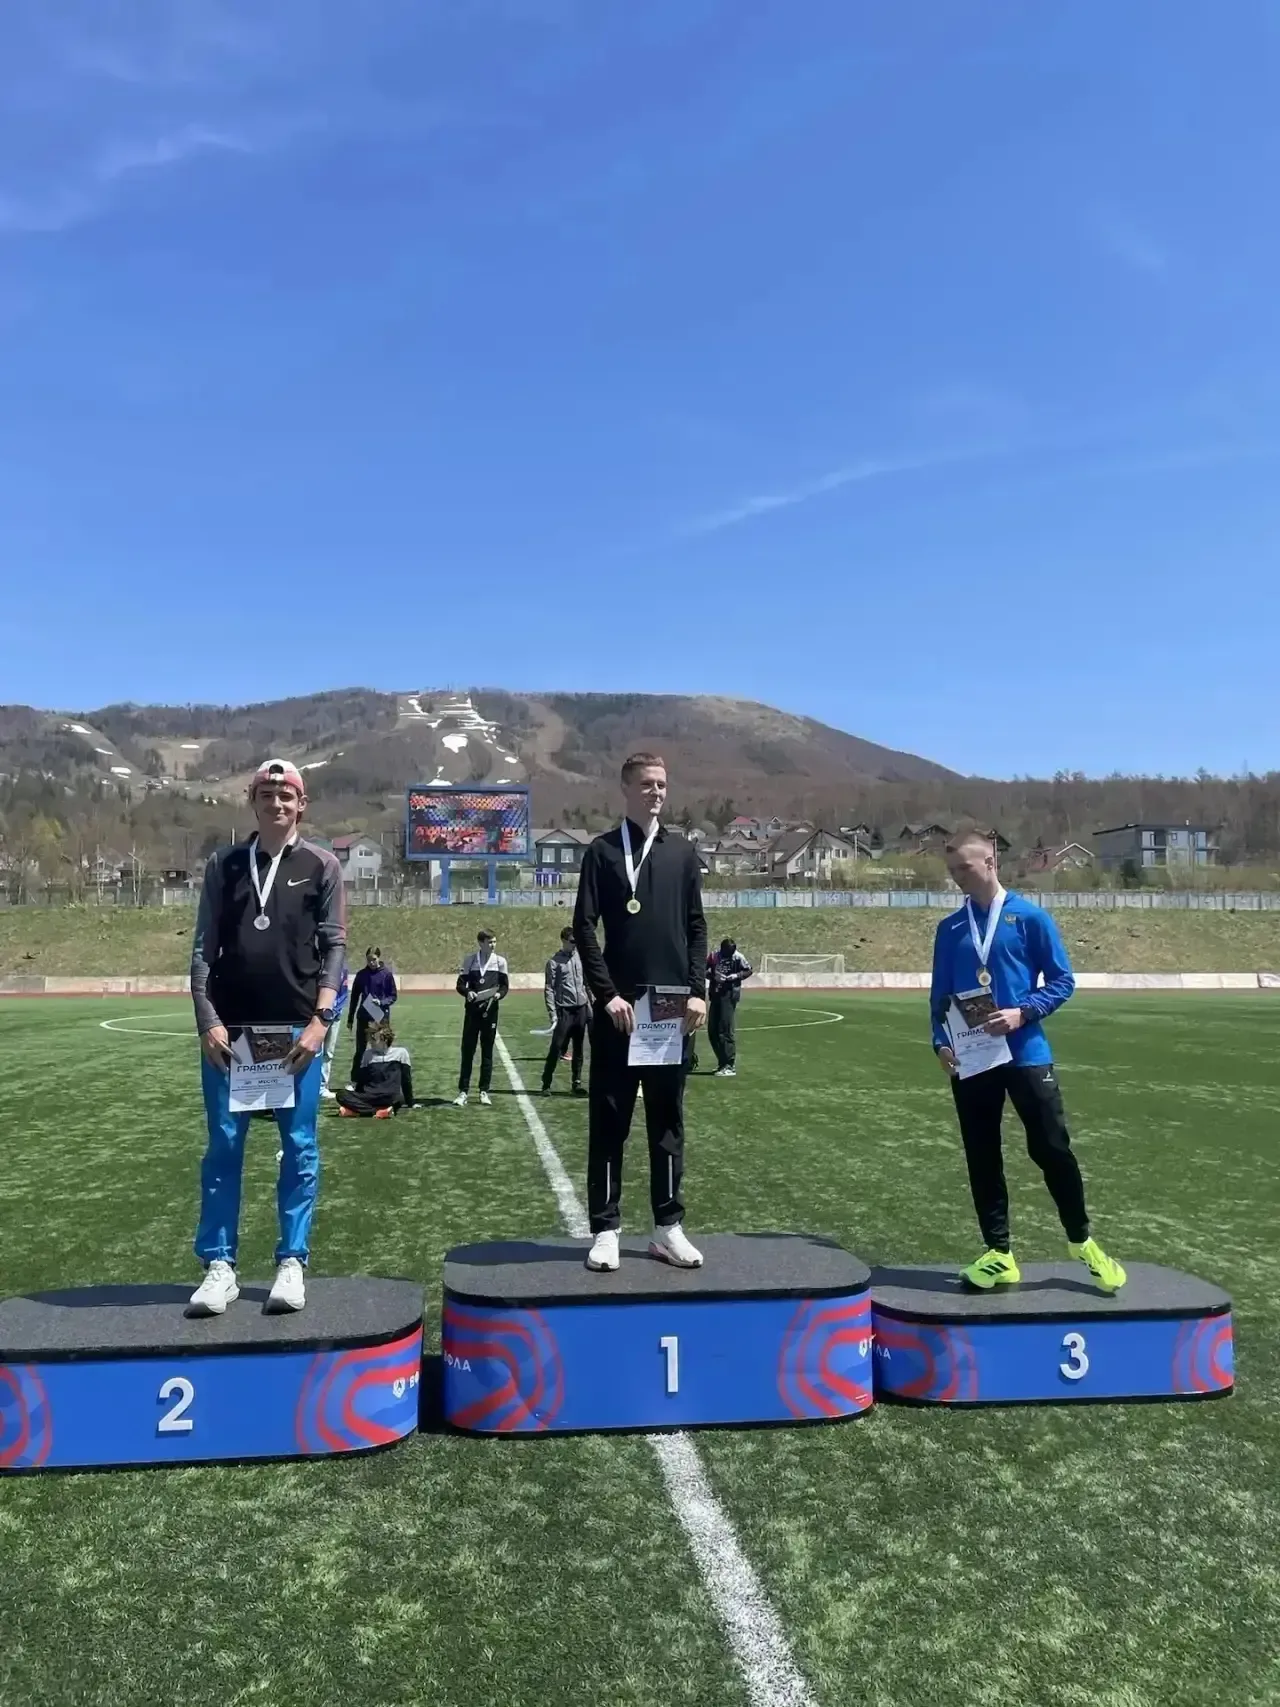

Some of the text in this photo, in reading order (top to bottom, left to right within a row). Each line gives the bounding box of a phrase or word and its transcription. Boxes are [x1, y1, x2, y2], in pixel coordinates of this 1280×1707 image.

[237, 1063, 286, 1073] ГРАМОТА
[660, 1336, 679, 1393] 1
[1059, 1332, 1089, 1380] 3
[158, 1377, 195, 1432] 2
